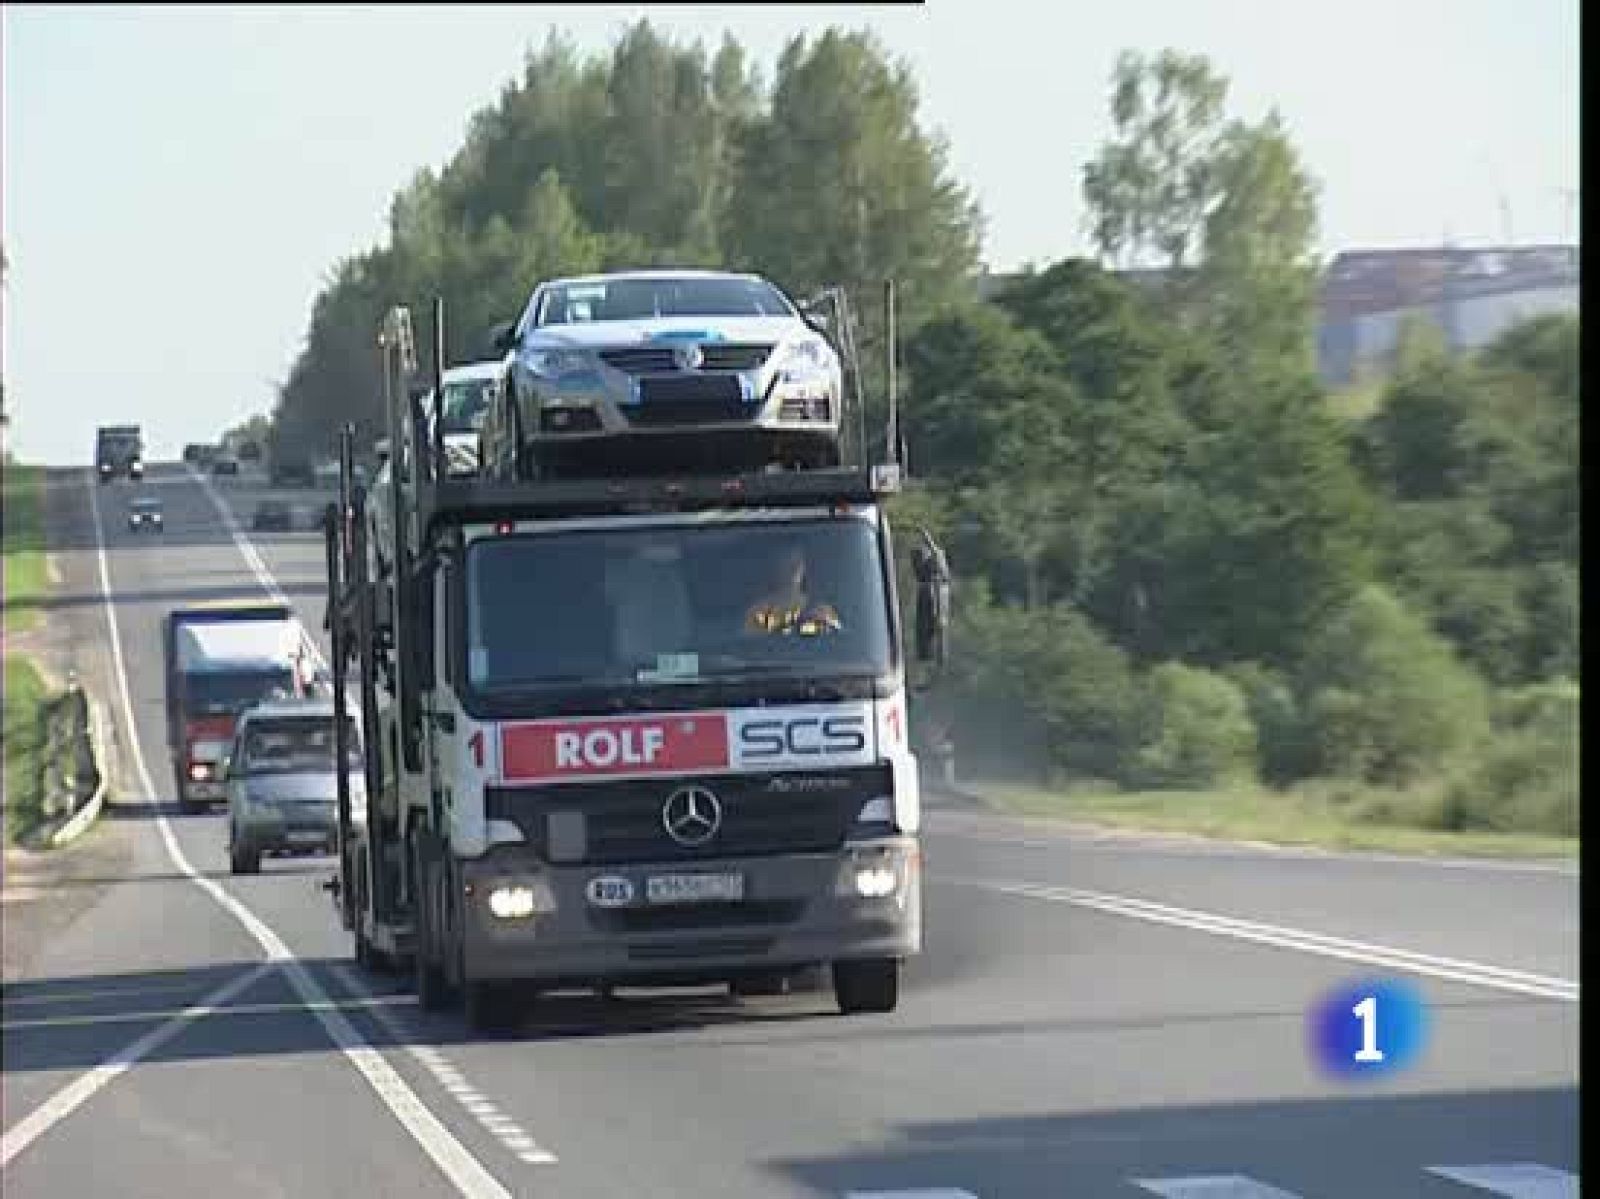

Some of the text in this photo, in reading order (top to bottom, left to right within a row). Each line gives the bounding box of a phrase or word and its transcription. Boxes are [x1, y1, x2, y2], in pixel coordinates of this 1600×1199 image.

[741, 715, 865, 757] SCS
[887, 707, 900, 742] 1
[468, 731, 483, 768] 1
[556, 726, 663, 768] ROLF
